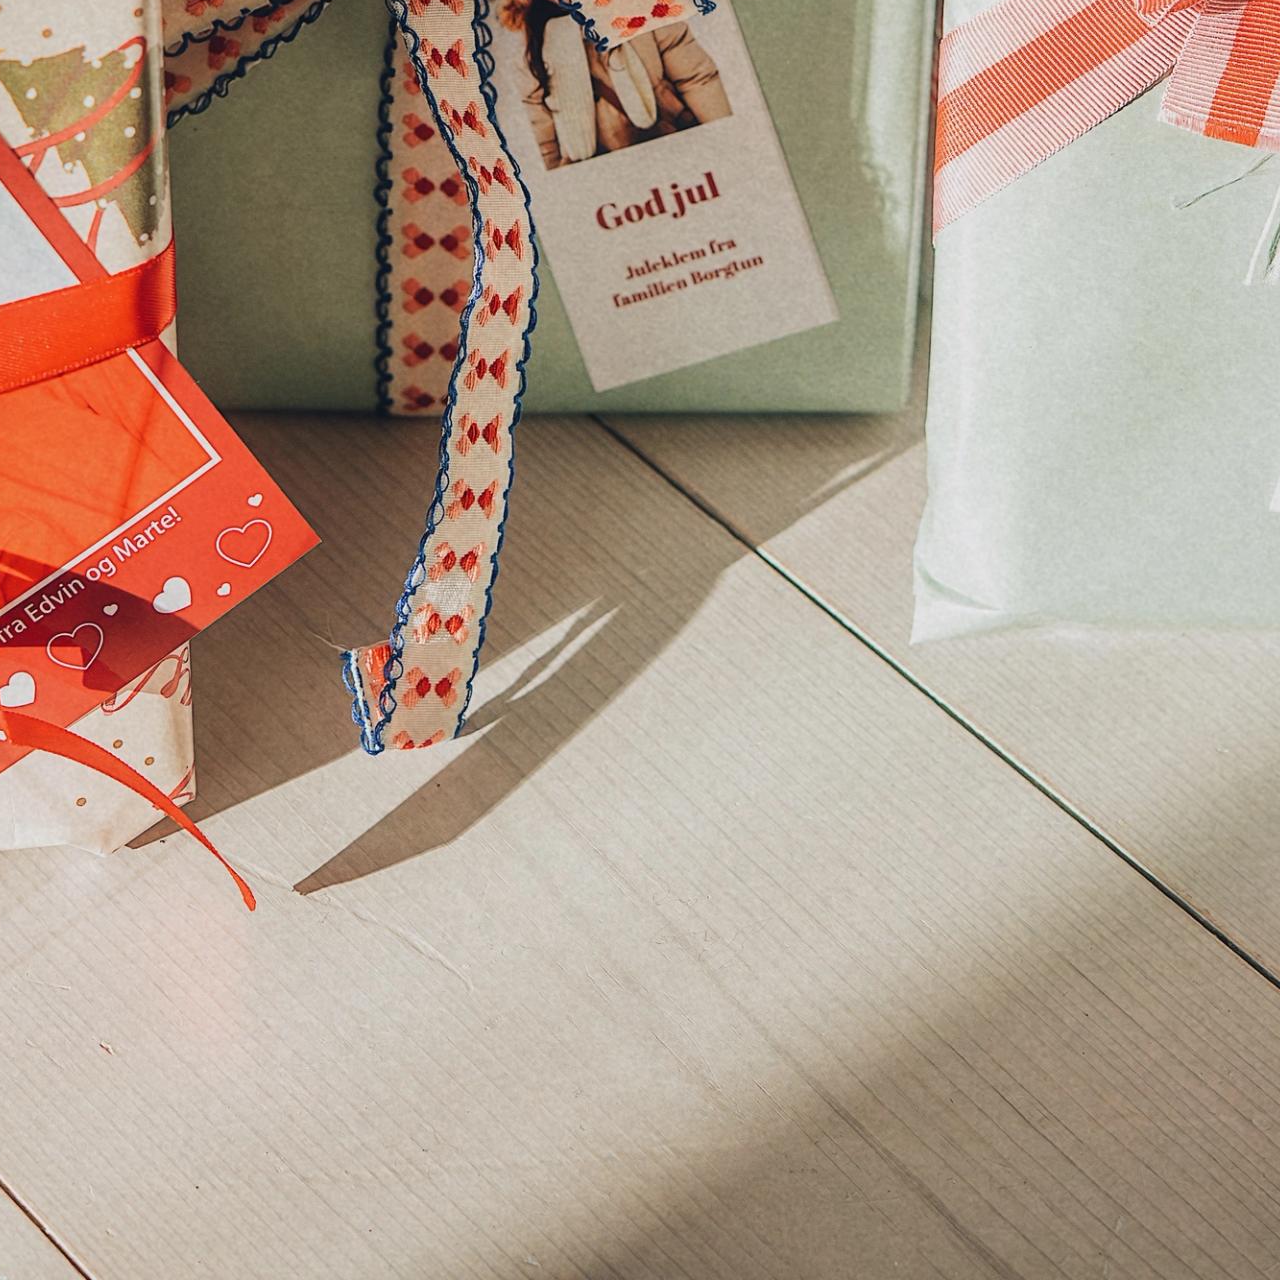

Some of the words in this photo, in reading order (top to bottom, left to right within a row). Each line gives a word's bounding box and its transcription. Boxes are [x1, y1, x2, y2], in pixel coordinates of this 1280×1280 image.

[595, 187, 667, 230] God
[670, 171, 721, 219] jul
[612, 279, 689, 308] familien
[691, 255, 764, 285] Borgtun
[626, 248, 708, 280] Juleklem
[709, 238, 737, 255] fra
[23, 579, 86, 624] Edvin
[85, 556, 118, 583] og
[111, 505, 183, 564] Marte!
